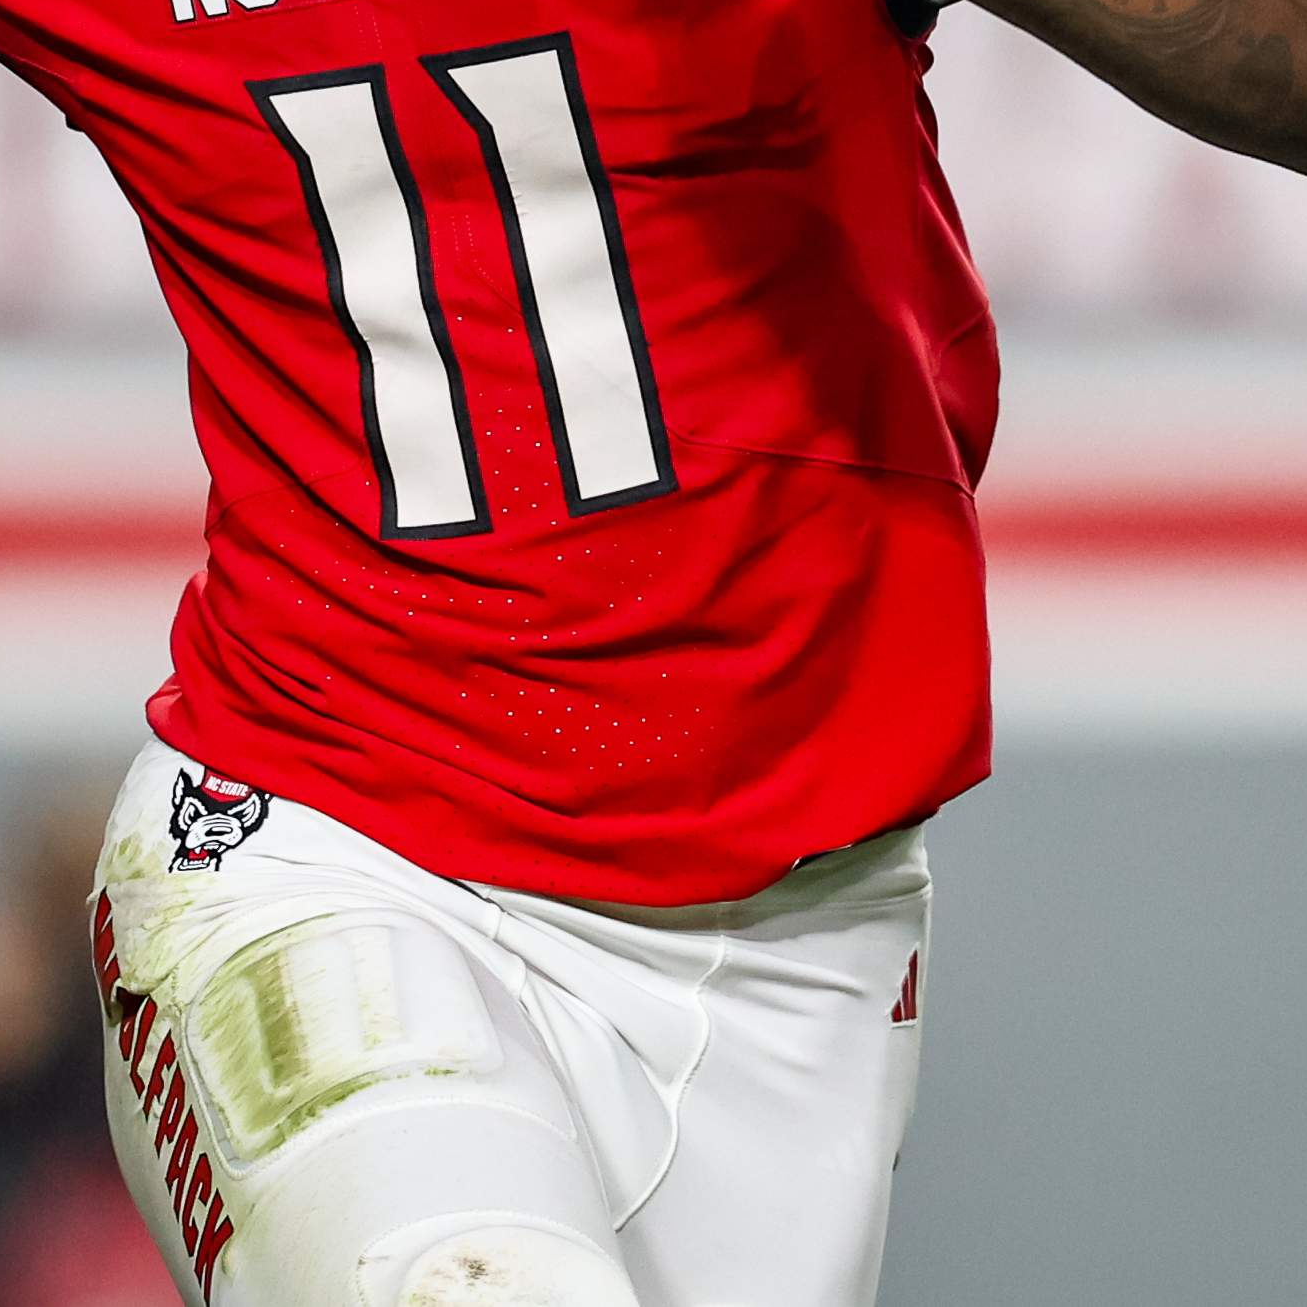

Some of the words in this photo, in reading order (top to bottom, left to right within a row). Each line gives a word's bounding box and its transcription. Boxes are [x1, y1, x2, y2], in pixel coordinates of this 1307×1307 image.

[243, 30, 680, 541] 11
[205, 775, 222, 792] NC
[218, 780, 250, 797] STATE
